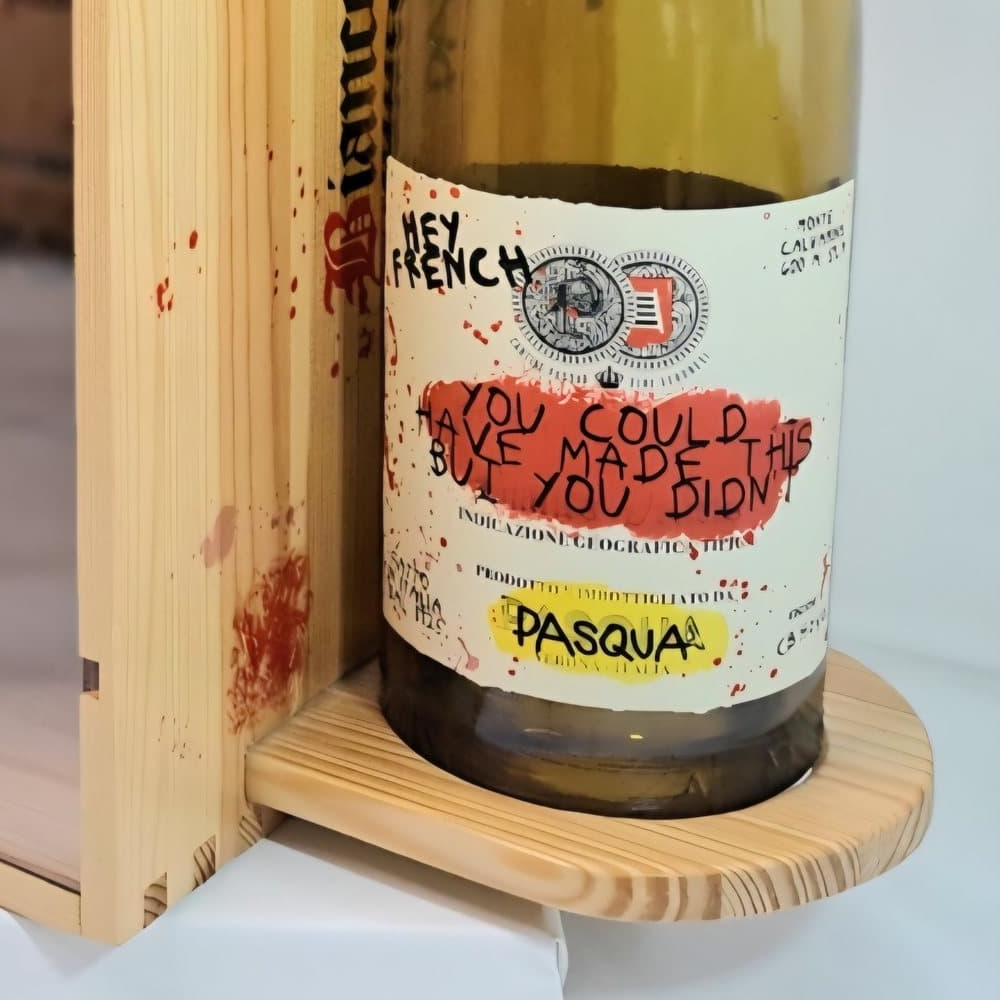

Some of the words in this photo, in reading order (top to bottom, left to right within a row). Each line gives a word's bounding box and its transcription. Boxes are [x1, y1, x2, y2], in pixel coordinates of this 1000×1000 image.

[402, 210, 459, 256] HEY
[393, 245, 532, 289] FRENCH
[416, 399, 522, 466] HAVE
[559, 436, 702, 482] MADE
[740, 420, 813, 478] THIS
[462, 382, 546, 433] YOU
[580, 404, 747, 447] COULD
[429, 438, 500, 504] BUT
[534, 470, 630, 518] YOU
[512, 604, 692, 663] PASQUA
